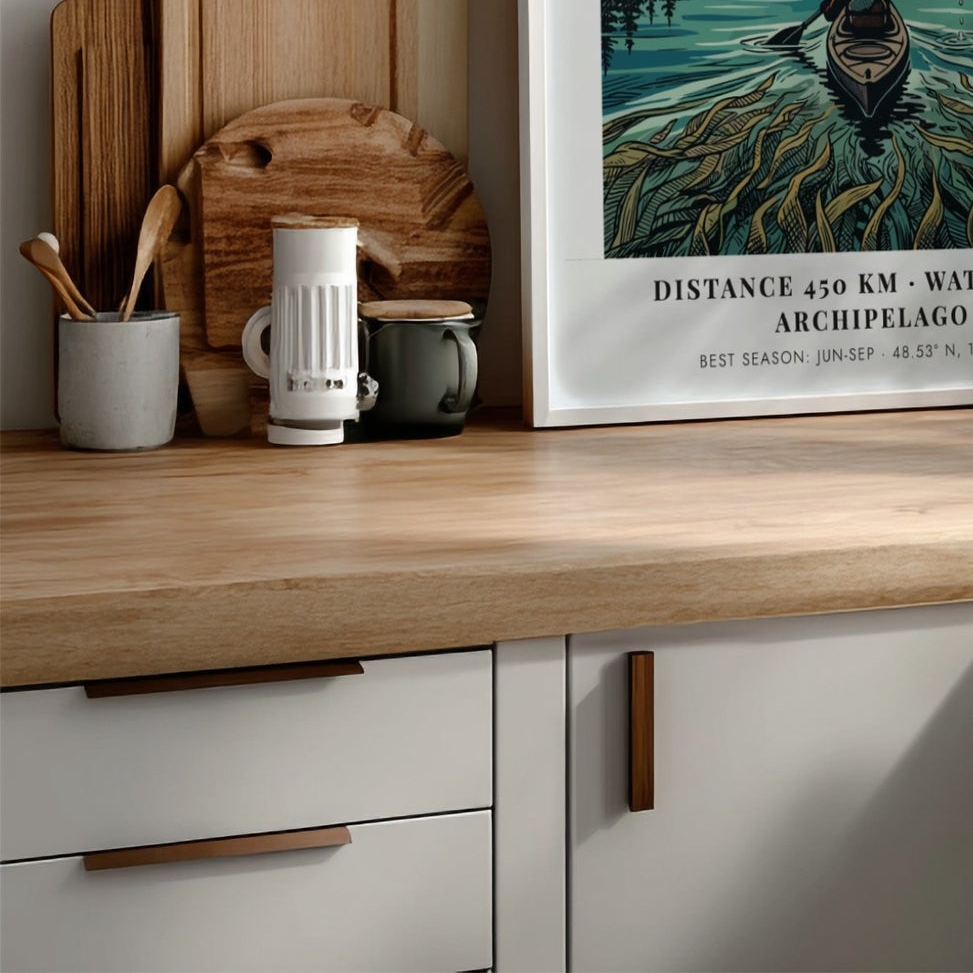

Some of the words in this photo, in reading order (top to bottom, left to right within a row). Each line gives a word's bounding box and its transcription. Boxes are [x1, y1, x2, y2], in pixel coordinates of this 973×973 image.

[654, 275, 793, 302] DISTANCE
[803, 278, 847, 300] 450
[858, 272, 897, 294] KM
[775, 304, 968, 333] ARCHIPELAGO
[699, 352, 735, 369] BEST
[742, 350, 809, 367] SEASON:
[815, 346, 875, 367] JUN-SEP
[892, 343, 939, 359] 48.53°
[945, 343, 961, 359] N,
